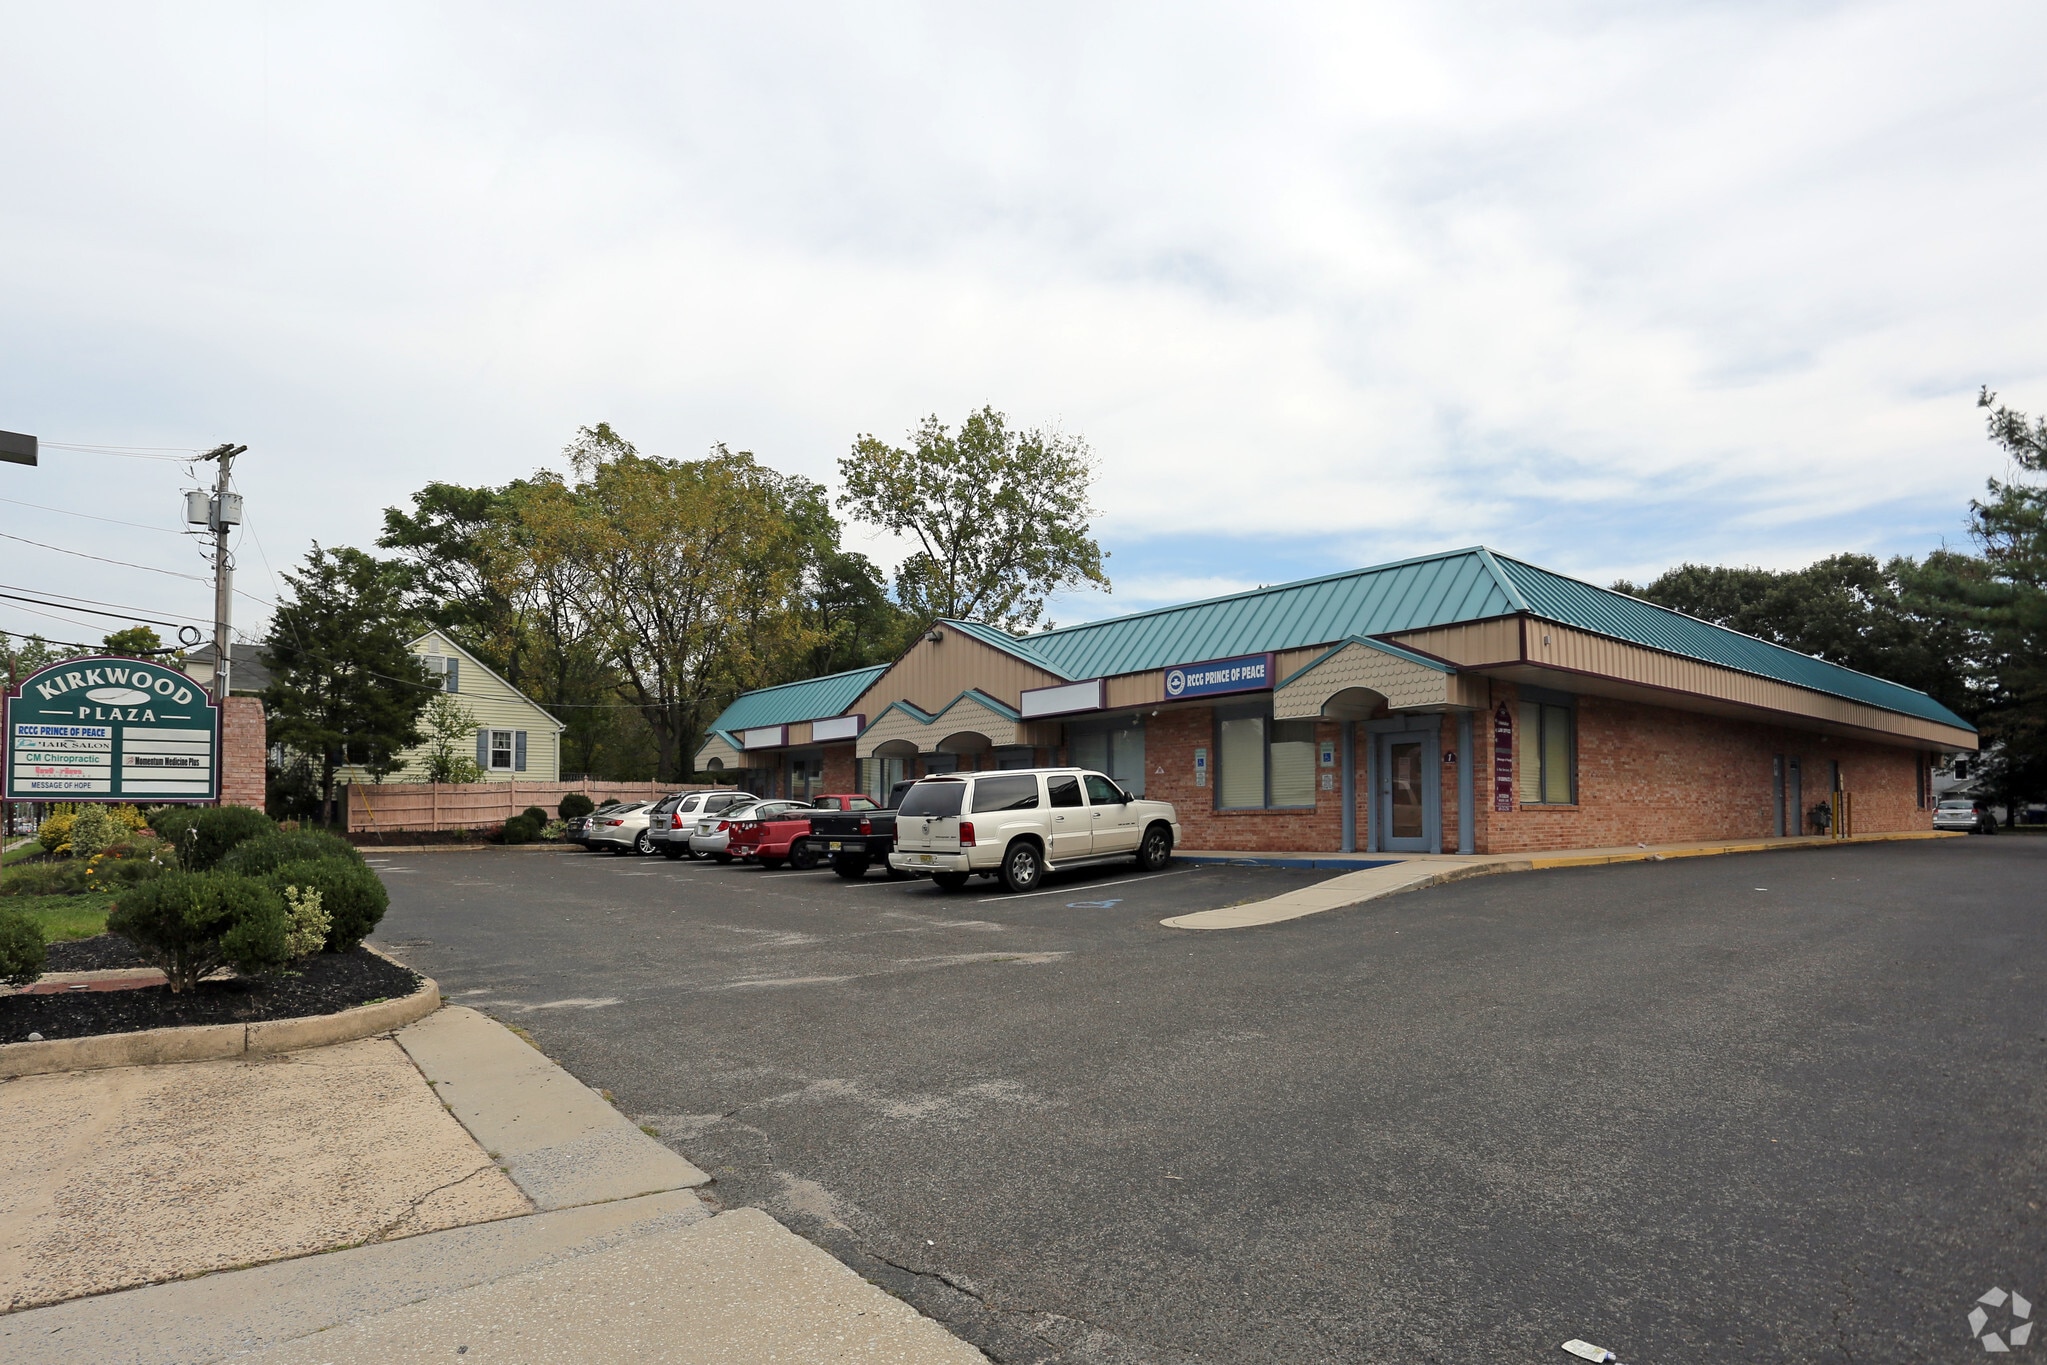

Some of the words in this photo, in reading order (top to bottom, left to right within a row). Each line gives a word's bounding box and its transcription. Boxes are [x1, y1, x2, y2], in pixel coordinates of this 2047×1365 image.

[1187, 672, 1204, 687] RCCG
[1205, 669, 1230, 685] PRINCE
[1231, 668, 1240, 682] OF
[1241, 664, 1265, 680] PEACE
[35, 667, 193, 705] KIRKWOOD
[79, 706, 156, 722] PLAZA
[18, 726, 38, 735] RCCG
[40, 726, 68, 736] PRINCE
[70, 727, 80, 736] OF
[81, 728, 105, 737] PEACE
[26, 753, 42, 762] CM
[44, 753, 100, 764] Chiropractic
[135, 756, 164, 766] Momentum
[164, 757, 188, 766] Medicine
[188, 757, 200, 767] Plus
[31, 781, 62, 789] MESSAGE
[64, 781, 73, 789] OF
